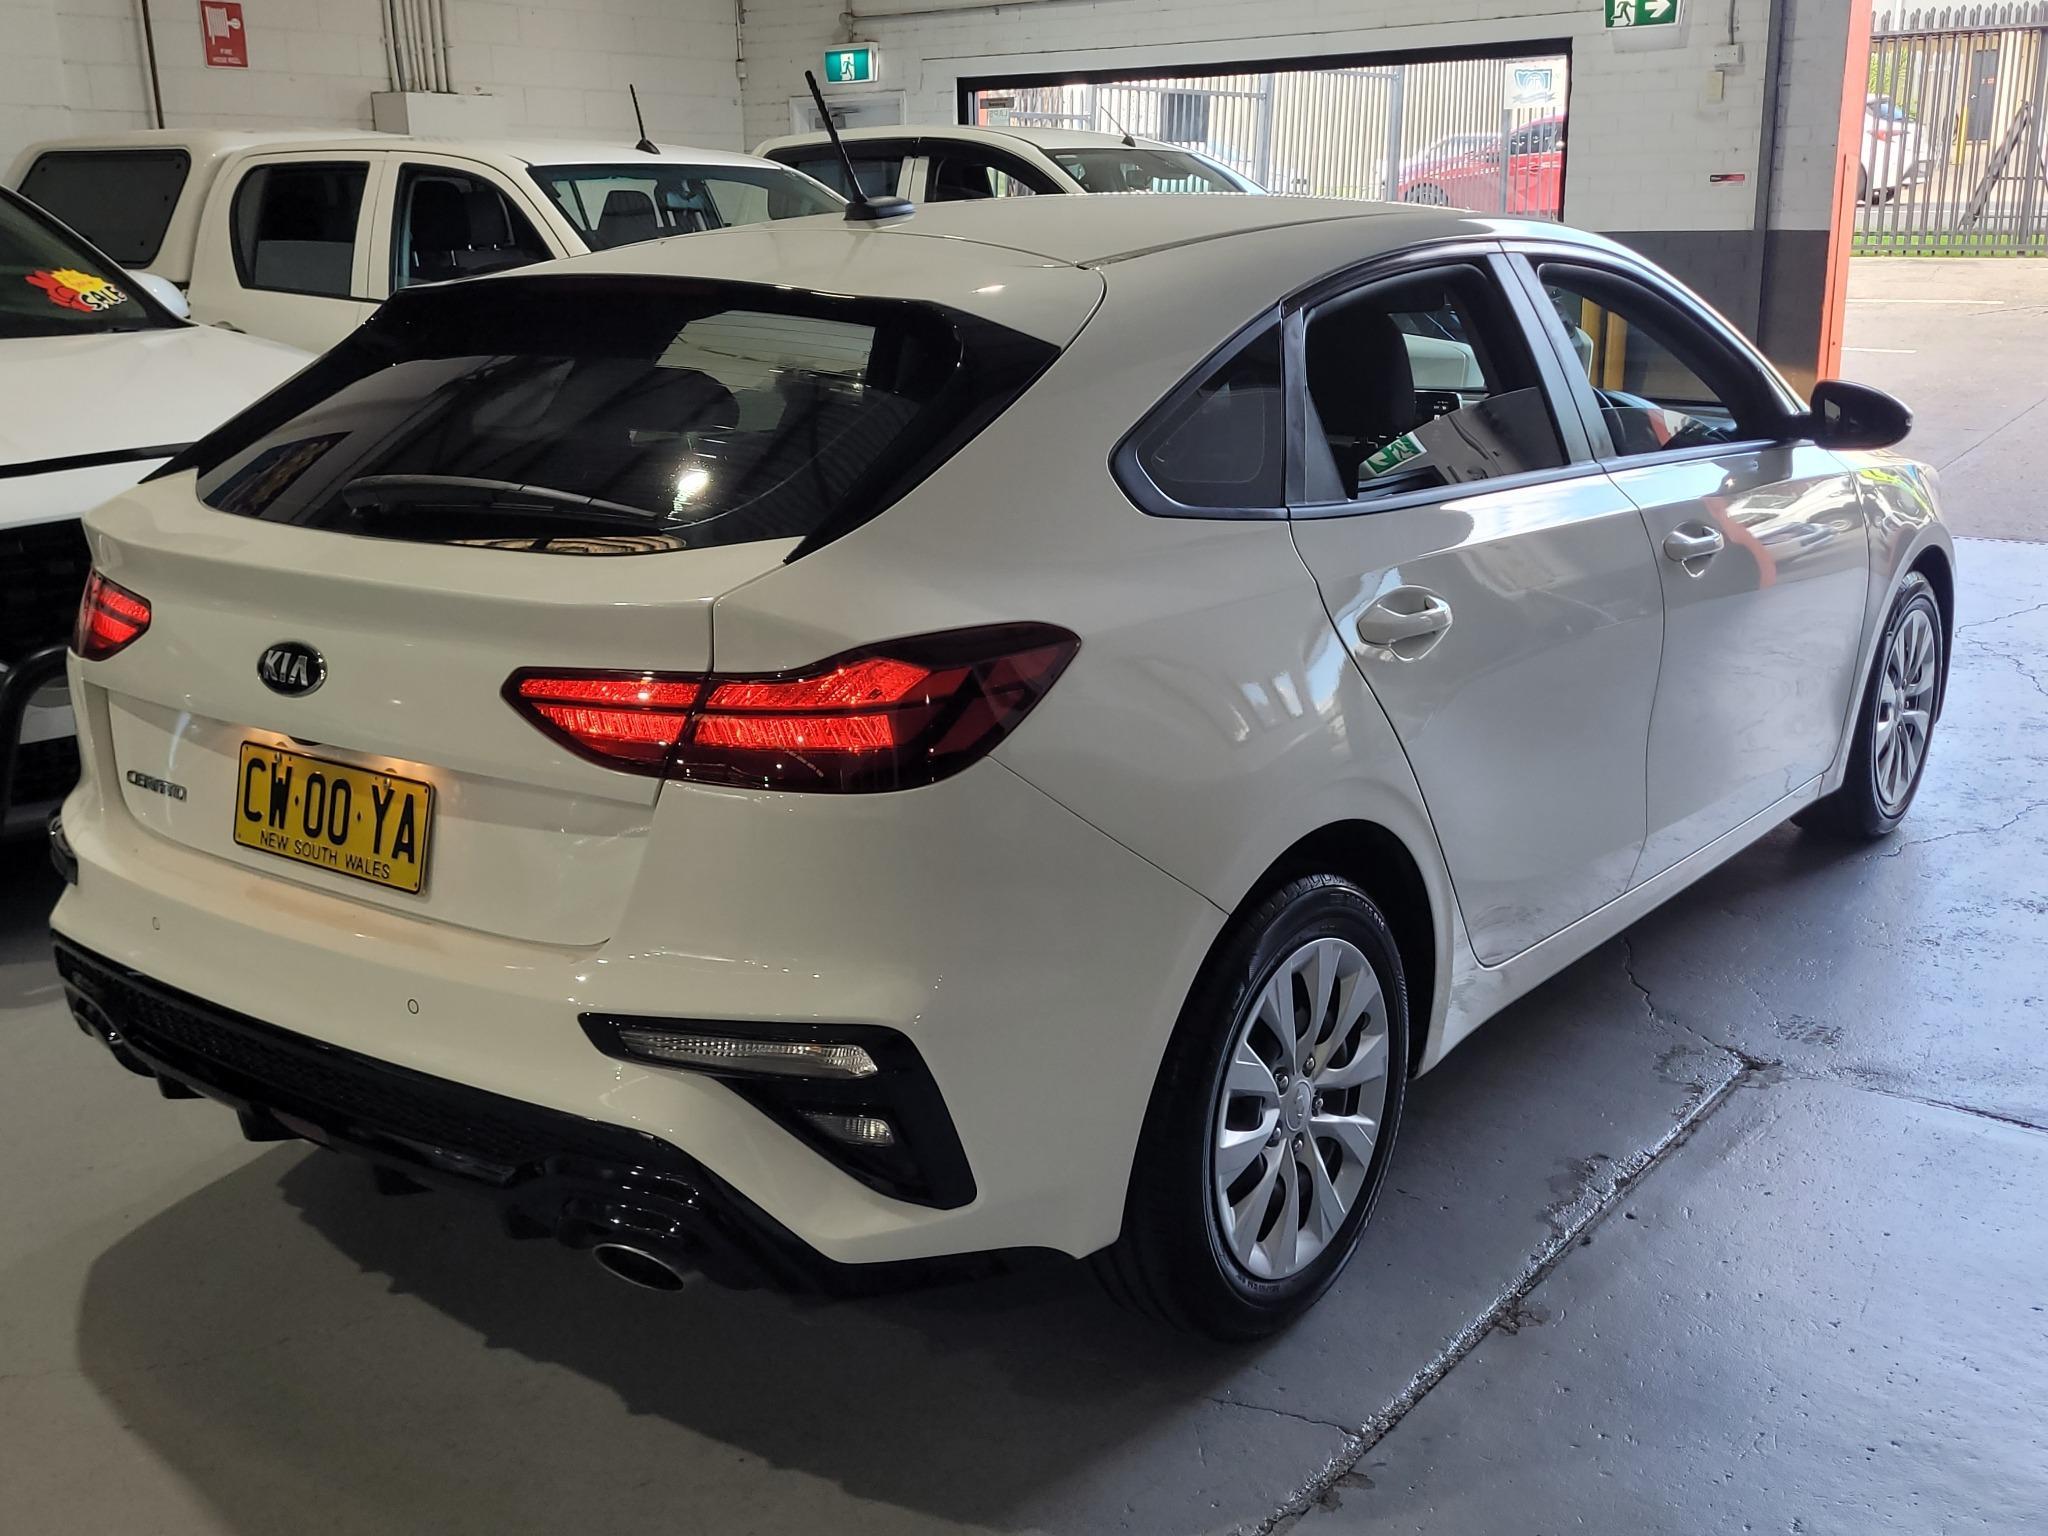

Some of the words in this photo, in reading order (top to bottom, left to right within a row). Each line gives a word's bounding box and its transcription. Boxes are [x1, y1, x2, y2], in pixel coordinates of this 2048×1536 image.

[81, 285, 127, 310] SALE
[263, 649, 309, 686] KIA
[259, 830, 289, 852] NEW
[293, 840, 338, 866] SOUTH
[344, 853, 391, 880] WALES
